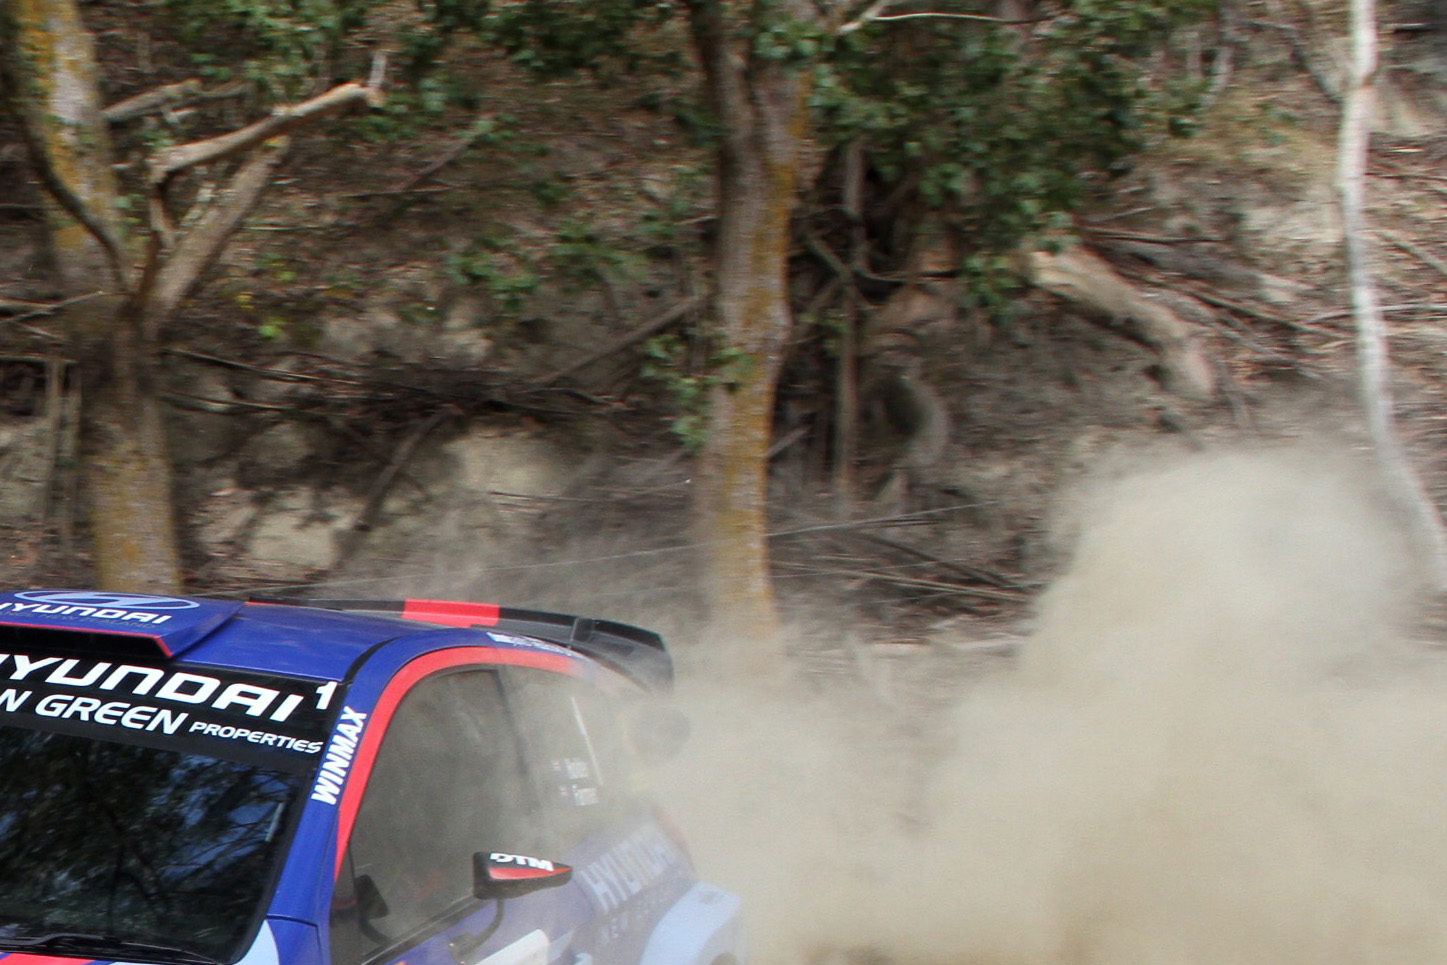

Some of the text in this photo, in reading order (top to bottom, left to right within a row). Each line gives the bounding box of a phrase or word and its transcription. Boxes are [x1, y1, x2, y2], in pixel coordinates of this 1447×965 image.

[315, 681, 338, 710] 1
[35, 696, 189, 736] GREEN
[189, 720, 324, 754] PROPERTIES
[311, 706, 367, 805] WINMAX
[489, 852, 555, 872] DTM
